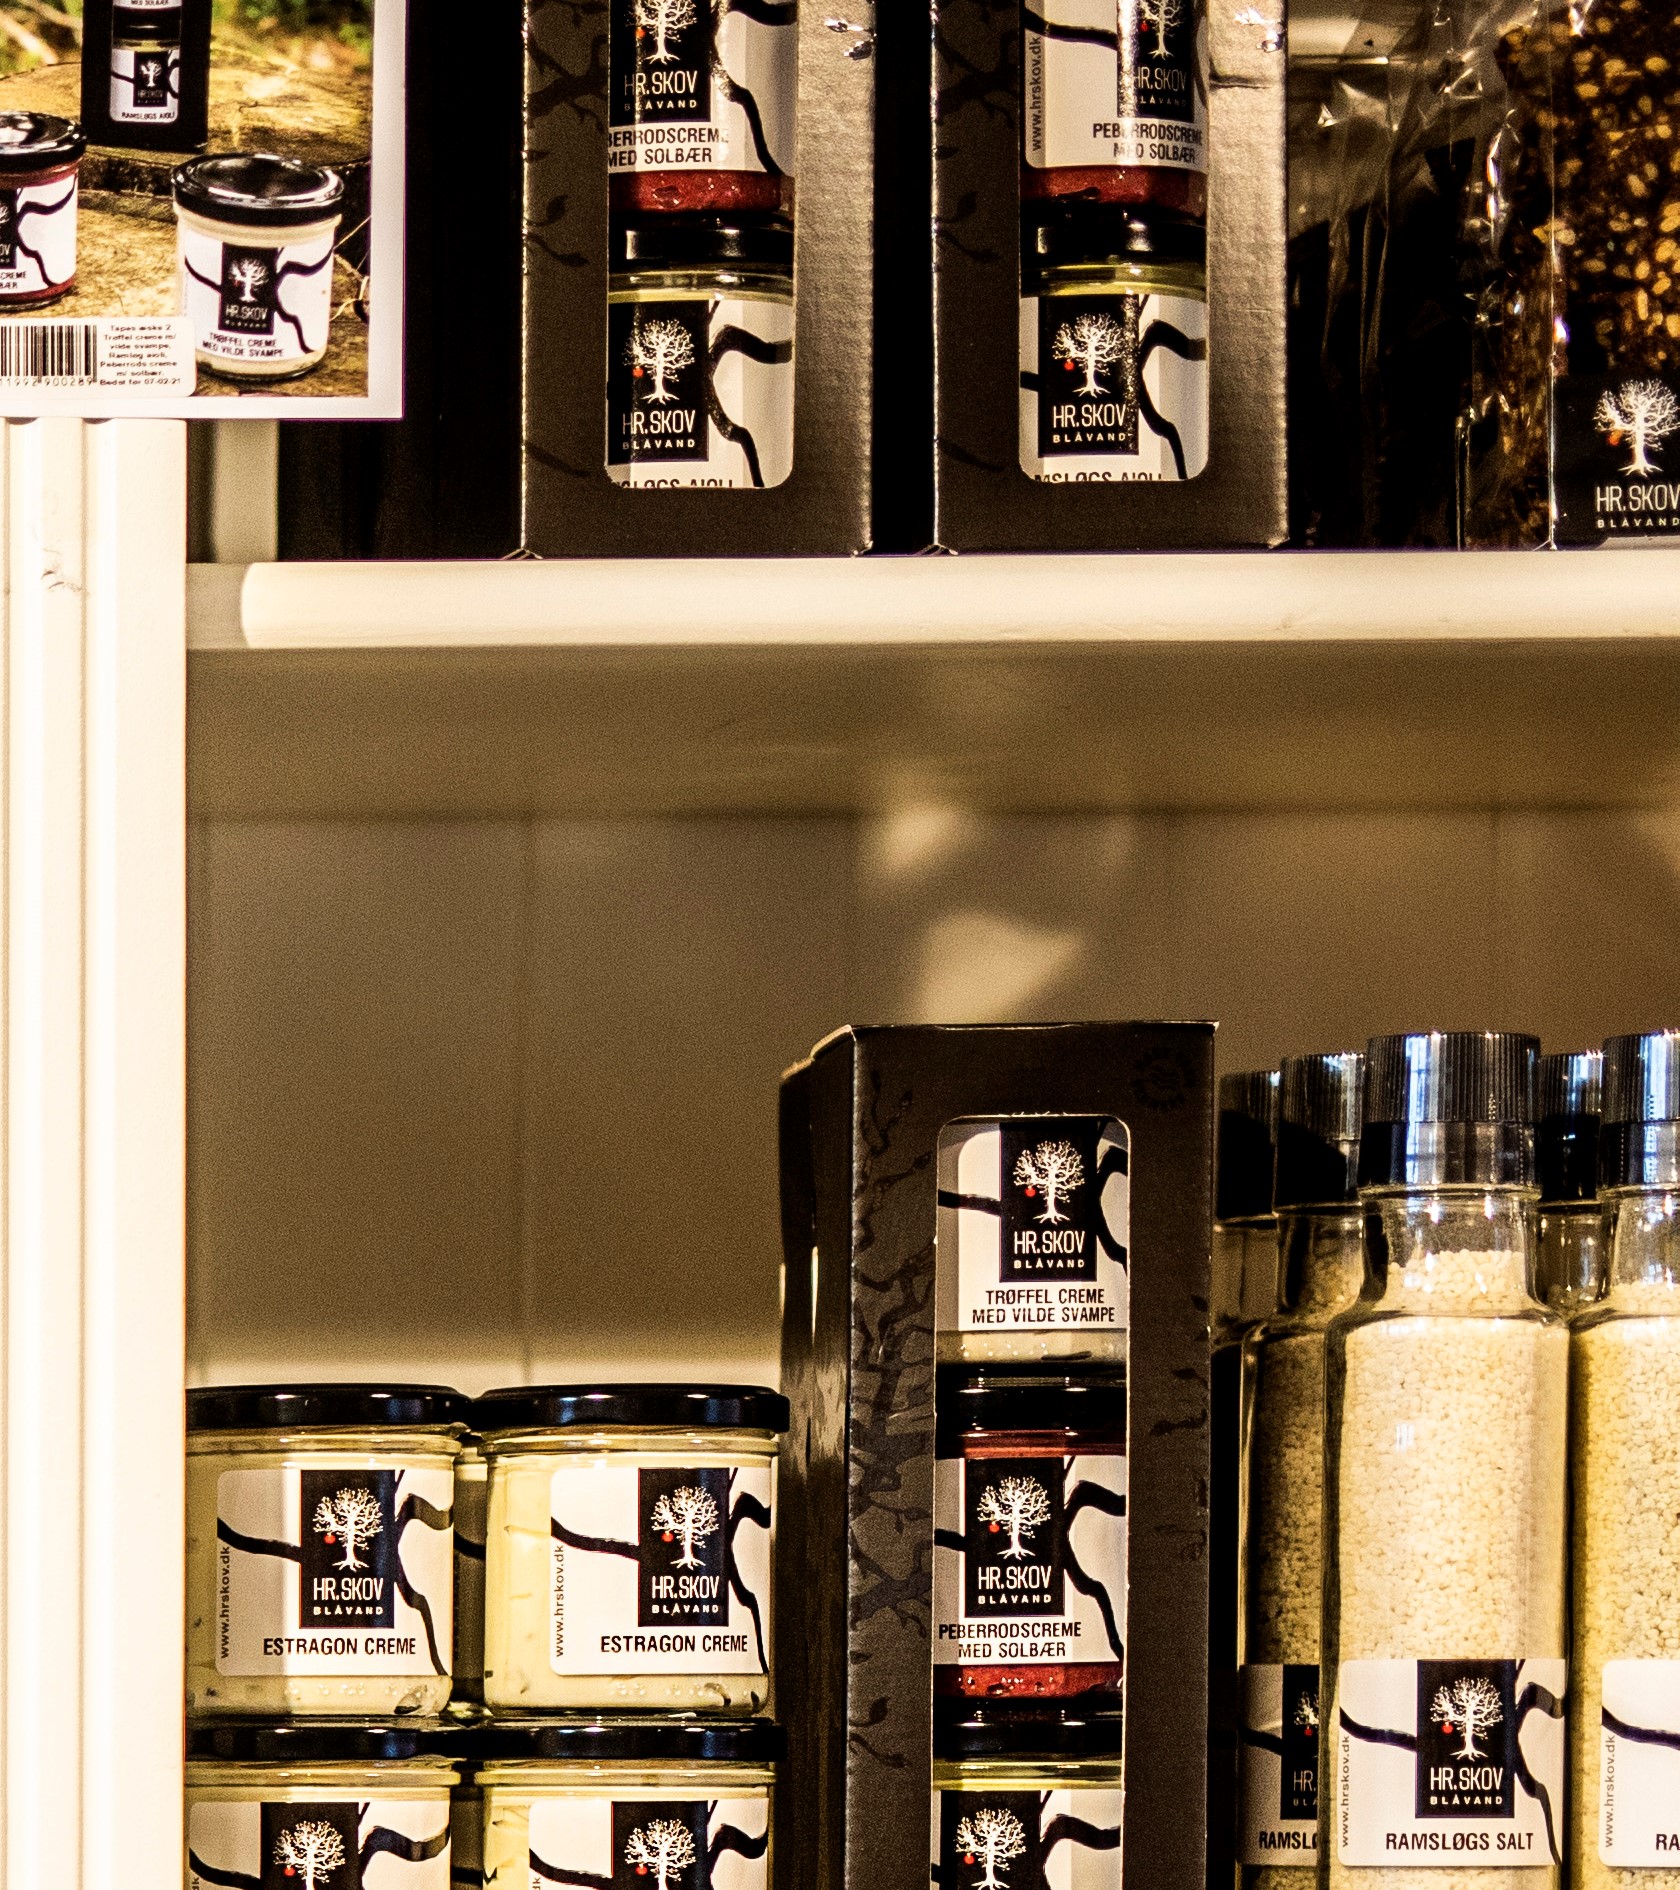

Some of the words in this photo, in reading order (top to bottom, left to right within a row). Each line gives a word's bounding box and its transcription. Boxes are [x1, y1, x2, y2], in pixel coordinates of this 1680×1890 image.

[1029, 36, 1041, 151] www.hrskov.dk
[1052, 403, 1126, 430] HR.SKOV
[1052, 431, 1126, 442] BLÅVAND
[985, 1288, 1053, 1305] TRØFFEL
[1058, 1288, 1105, 1305] CREME
[972, 1308, 1006, 1324] MED
[1012, 1307, 1055, 1323] VILDE
[1061, 1306, 1116, 1323] SVAMPE
[977, 1565, 1052, 1590] HR.SKOV
[977, 1593, 1052, 1605] BLÅVAND
[937, 1620, 1082, 1641] PEBERRODSCREME
[600, 1634, 696, 1654] ESTRAGON
[702, 1634, 748, 1653] CREME
[956, 1642, 991, 1659] MED
[998, 1641, 1066, 1659] SOLBÆR
[1385, 1832, 1490, 1851] RAMSLØGS
[1496, 1832, 1534, 1851] SALT
